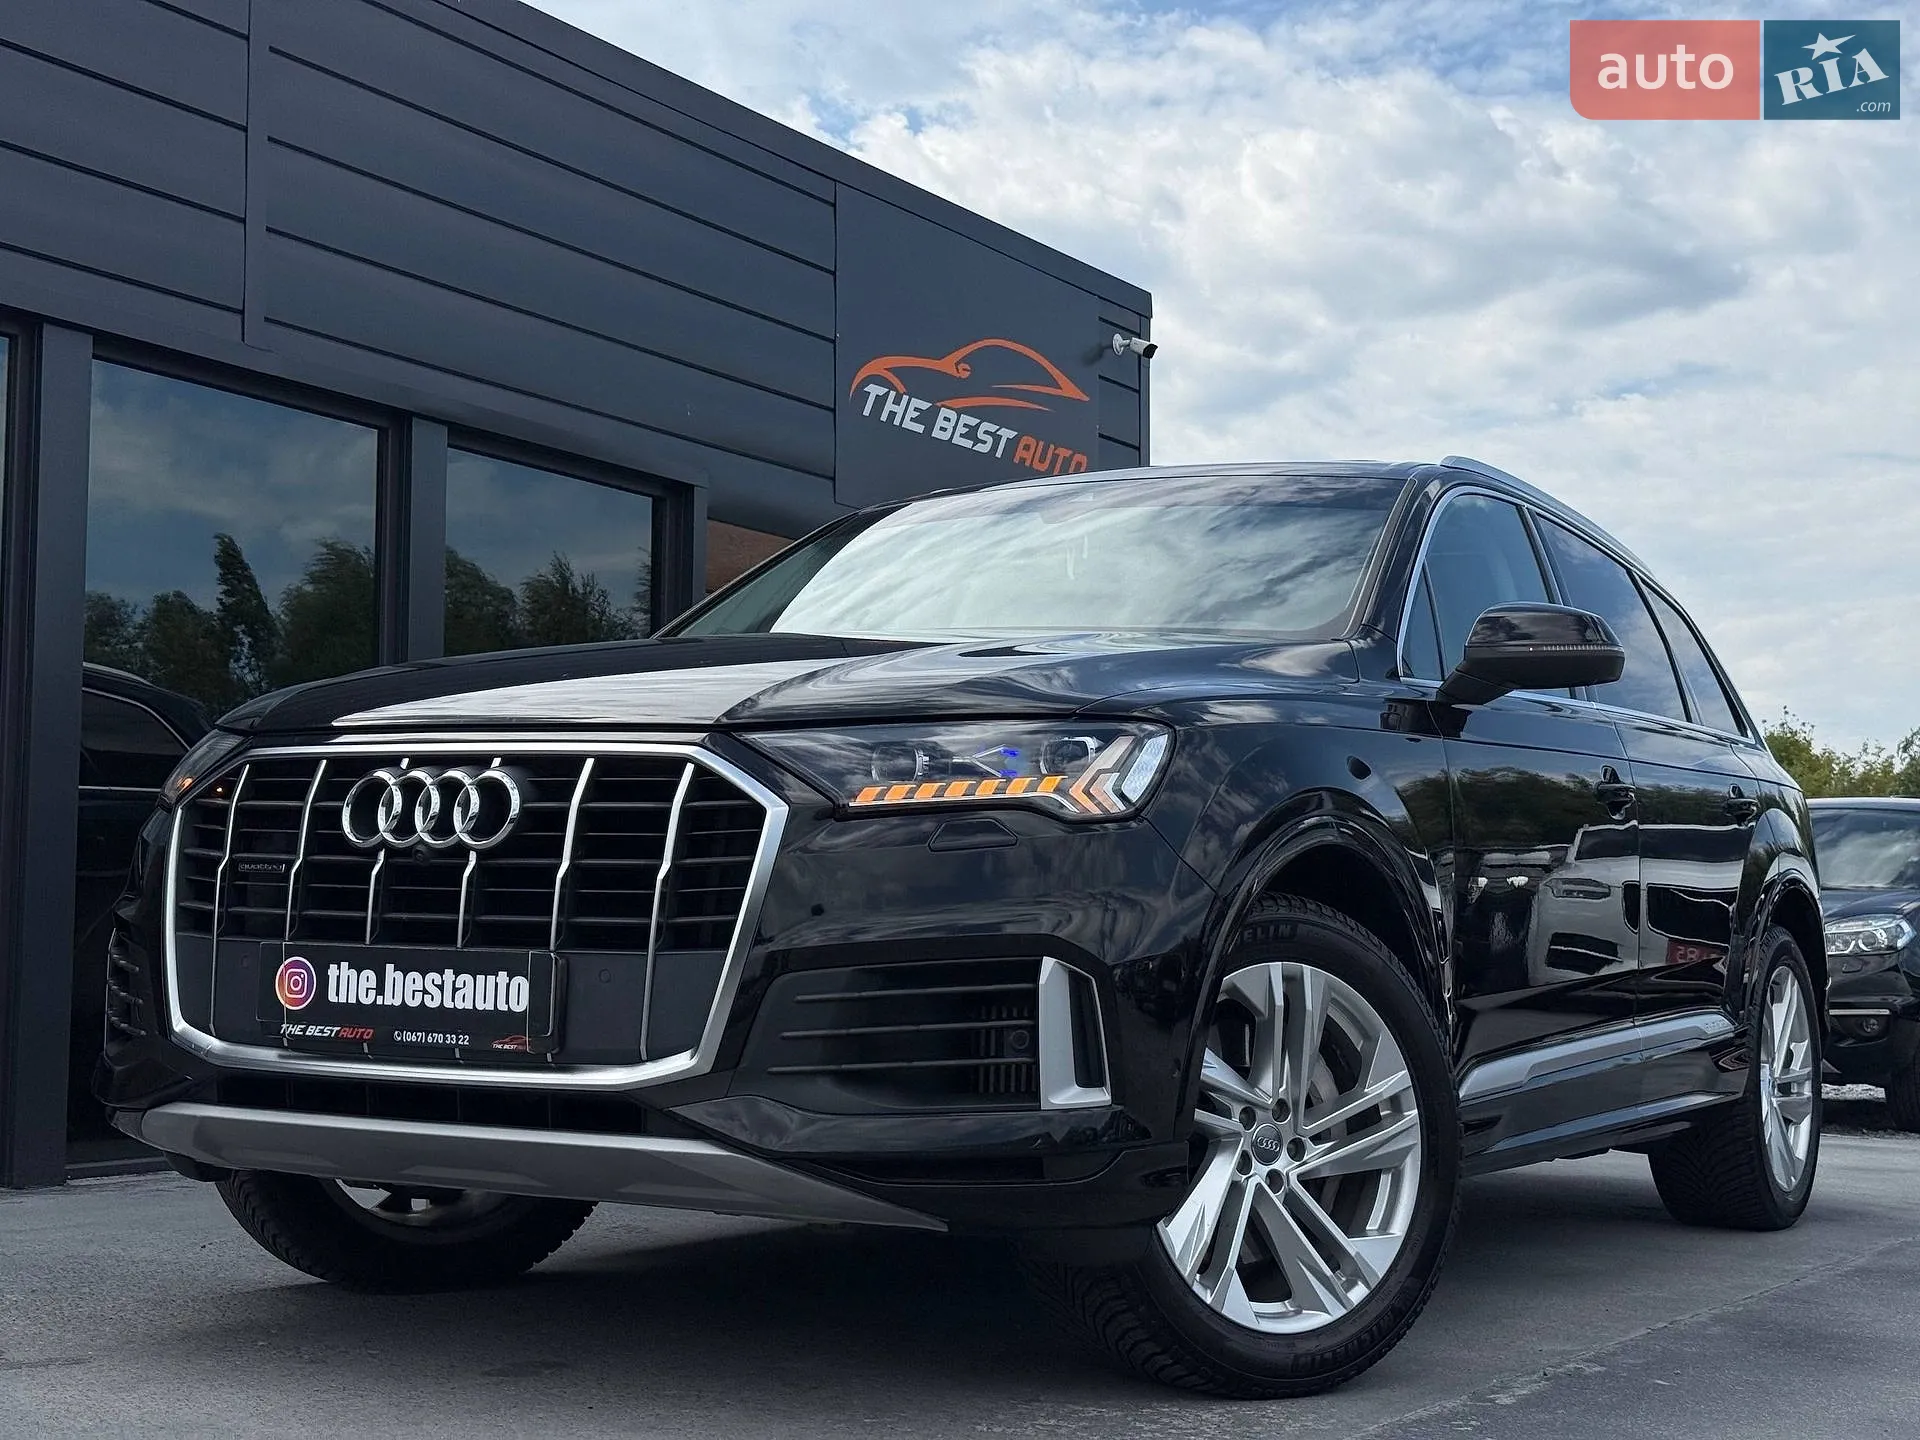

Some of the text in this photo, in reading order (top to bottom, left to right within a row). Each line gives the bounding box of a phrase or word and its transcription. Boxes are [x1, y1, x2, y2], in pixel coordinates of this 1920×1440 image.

[863, 383, 1088, 476] THE BEST AUTO
[327, 961, 529, 1013] the.bestauto
[280, 1023, 374, 1040] THE BEST AUTO
[402, 1031, 469, 1046] (067) 670 33 22
